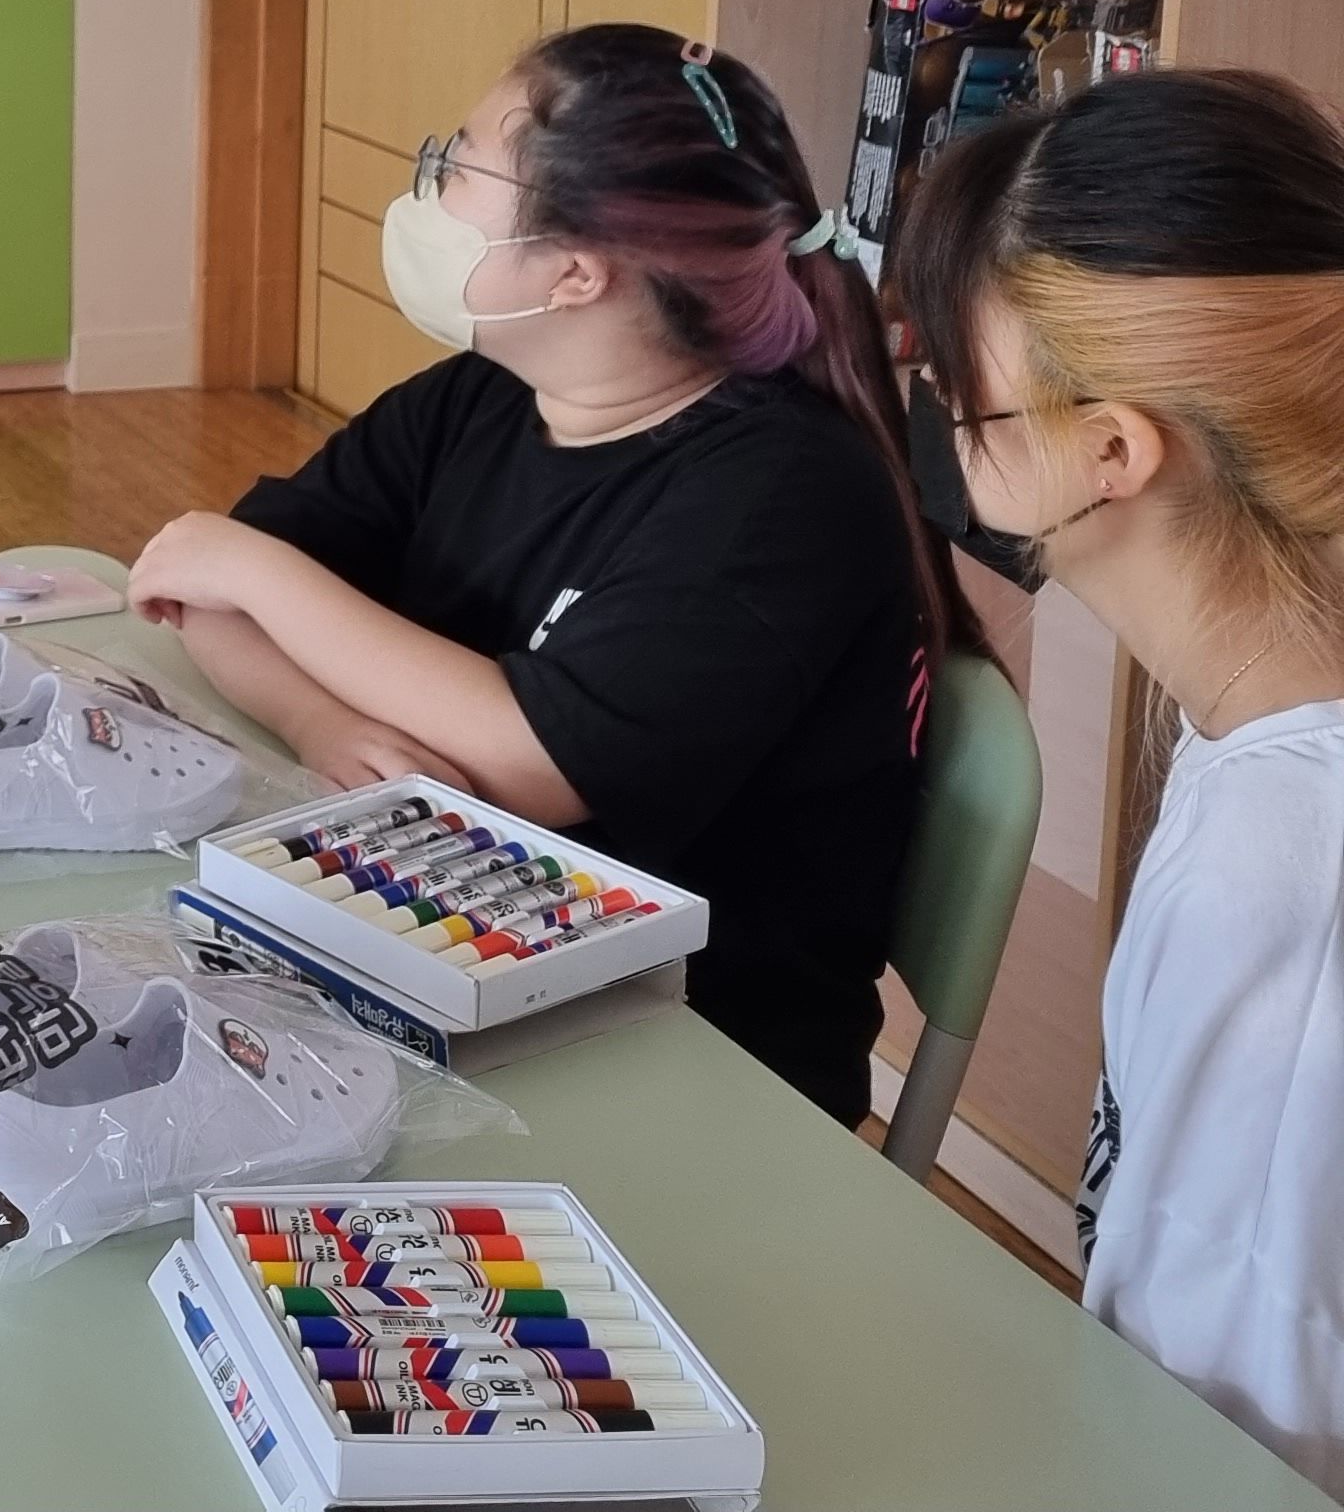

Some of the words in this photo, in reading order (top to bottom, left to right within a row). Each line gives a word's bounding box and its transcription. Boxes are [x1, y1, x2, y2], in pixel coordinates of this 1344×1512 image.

[397, 1360, 408, 1380] OIL
[394, 1383, 408, 1402] INK
[406, 1383, 421, 1410] MAG
